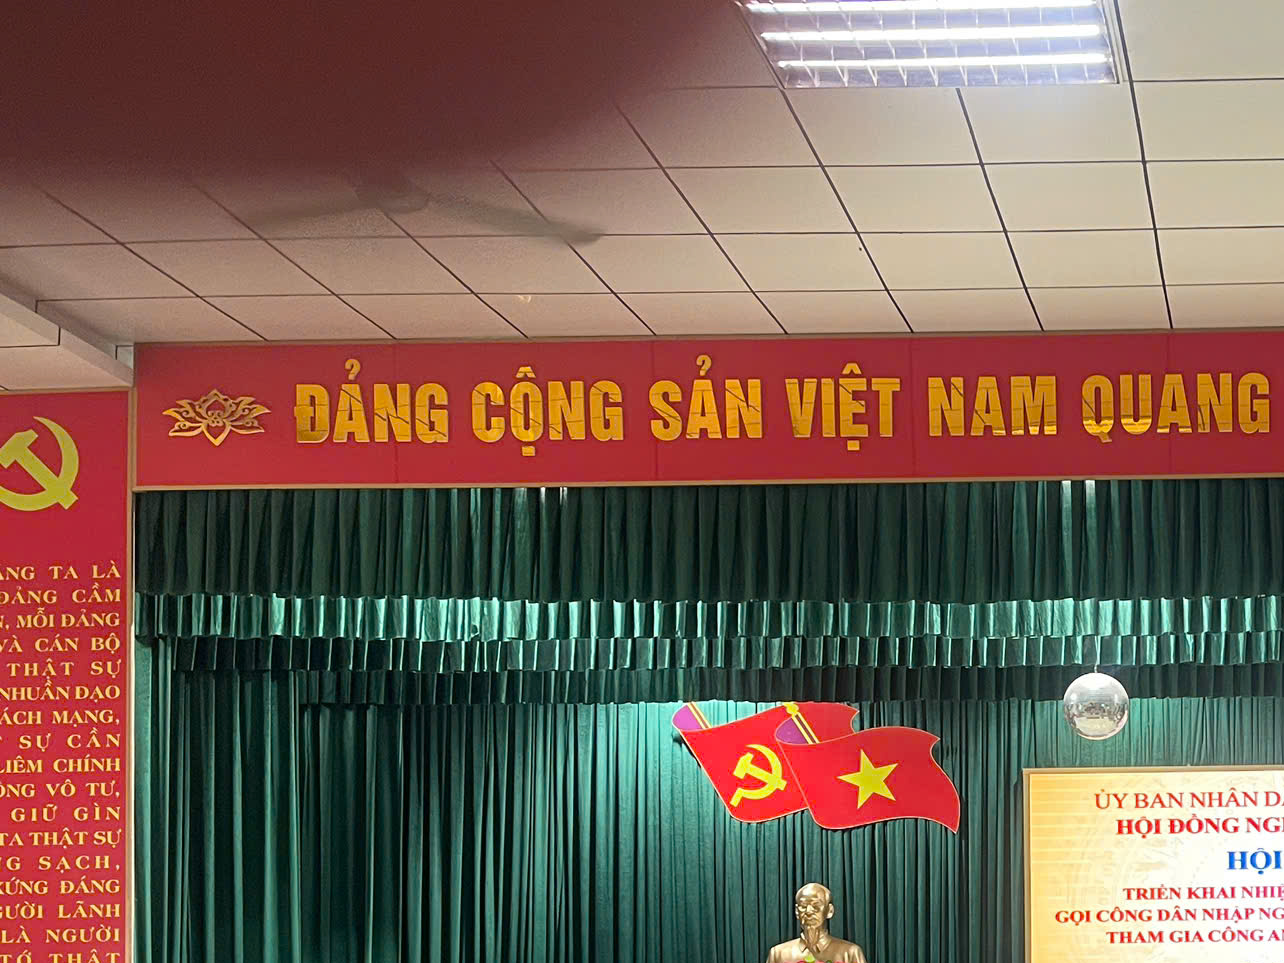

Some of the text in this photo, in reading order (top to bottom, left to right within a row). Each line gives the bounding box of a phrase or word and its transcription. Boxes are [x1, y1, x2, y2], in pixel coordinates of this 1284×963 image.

[294, 358, 450, 443] ĐẢNG
[470, 366, 624, 456] CỘNG
[650, 355, 763, 440] SẢN
[785, 362, 902, 451] VIỆT
[927, 375, 1057, 436] NAM
[1081, 372, 1271, 443] QUANG
[48, 565, 79, 579] TA
[92, 560, 121, 579] LÀ
[72, 582, 121, 603] CẦM
[16, 607, 55, 629] MỖI
[61, 608, 120, 628] ĐẢNG
[34, 632, 121, 654] CÁN BỘ
[6, 658, 122, 680] THẬT SỰ
[52, 709, 120, 728] MẠNG,
[19, 727, 121, 752] SỰ CẦN
[53, 753, 121, 773] CHÍNH
[46, 778, 76, 797] VÔ
[85, 780, 120, 798] TƯ,
[1094, 788, 1128, 809] ỦY
[1134, 792, 1184, 809] BAN
[1190, 787, 1259, 807] NHÂN
[10, 802, 121, 822] GIỮ GÌN
[1116, 816, 1162, 838] HỘI
[1168, 813, 1239, 834] ĐỒNG
[28, 827, 122, 849] THẬT SỰ
[38, 855, 120, 874] SẠCH,
[1227, 848, 1282, 875] HỘI
[60, 875, 121, 894] ĐÁNG
[1187, 887, 1236, 899] KHAI
[58, 900, 121, 919] LÃNH
[1055, 910, 1091, 926] GỌI
[1096, 906, 1152, 923] CÔNG
[1157, 906, 1197, 922] DÂN
[1202, 906, 1255, 924] NHẬP
[1, 924, 120, 943] LÀ NGƯỜI
[1106, 930, 1164, 944] THAM
[1169, 930, 1204, 943] GIA
[1208, 926, 1264, 942] CÔNG
